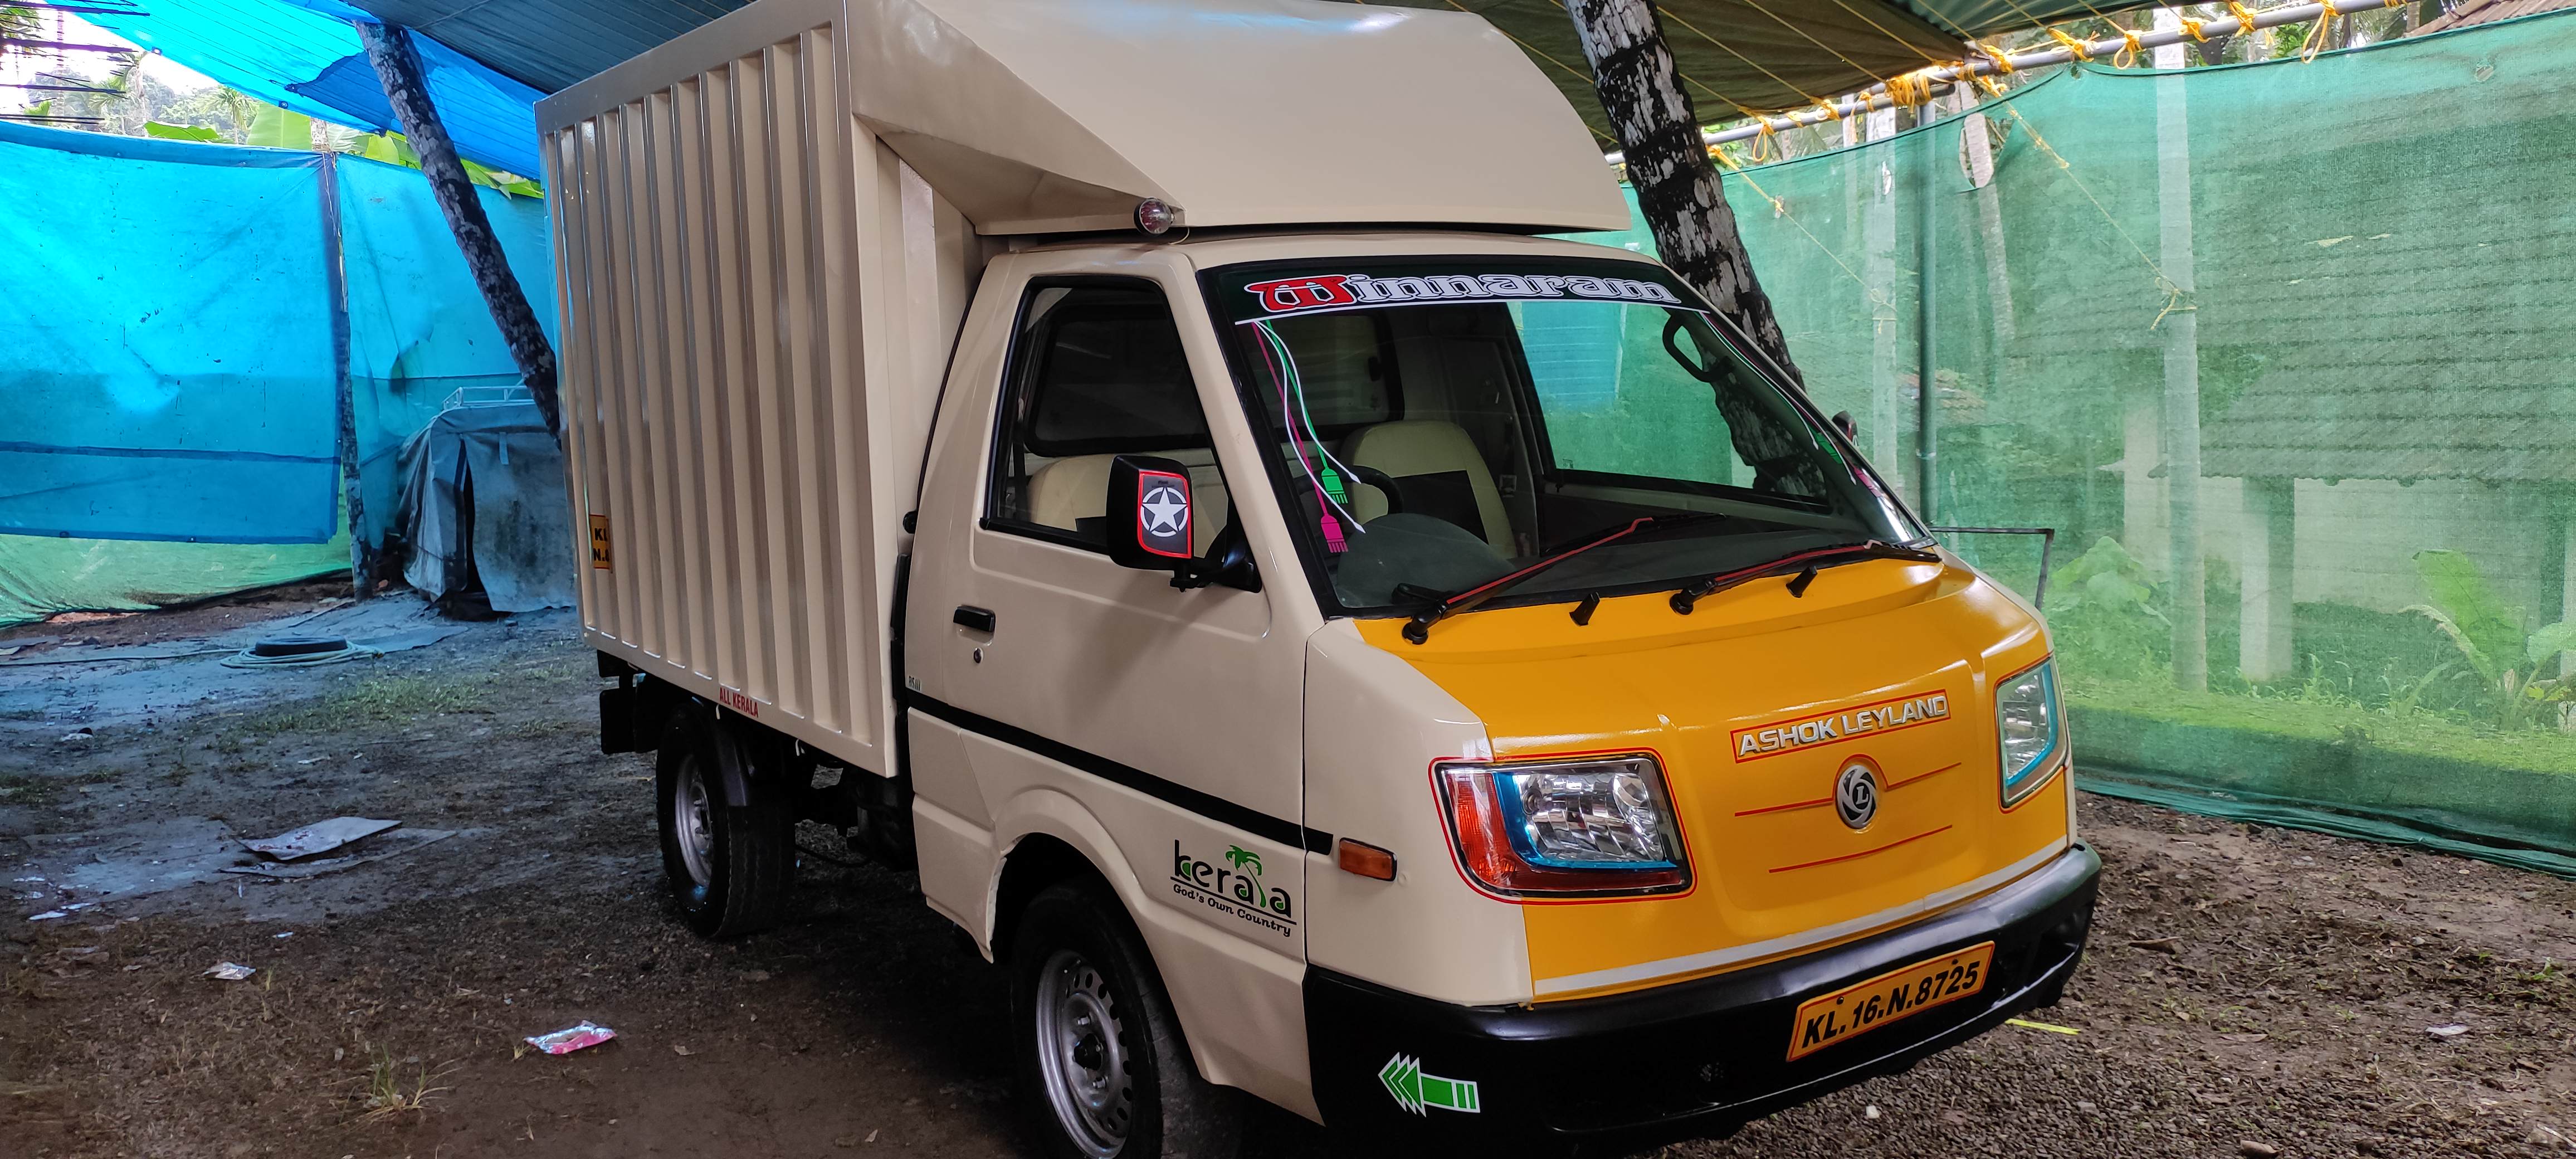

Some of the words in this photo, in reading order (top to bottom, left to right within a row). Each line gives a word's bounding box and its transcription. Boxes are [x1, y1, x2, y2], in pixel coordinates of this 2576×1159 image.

[720, 686, 731, 705] ALL
[733, 692, 758, 718] KERALA
[1738, 717, 1837, 757] ASHOK
[1841, 695, 1948, 735] LEYLAND
[1173, 883, 1204, 903] God's
[1207, 897, 1234, 914] Own
[1237, 908, 1291, 937] Country
